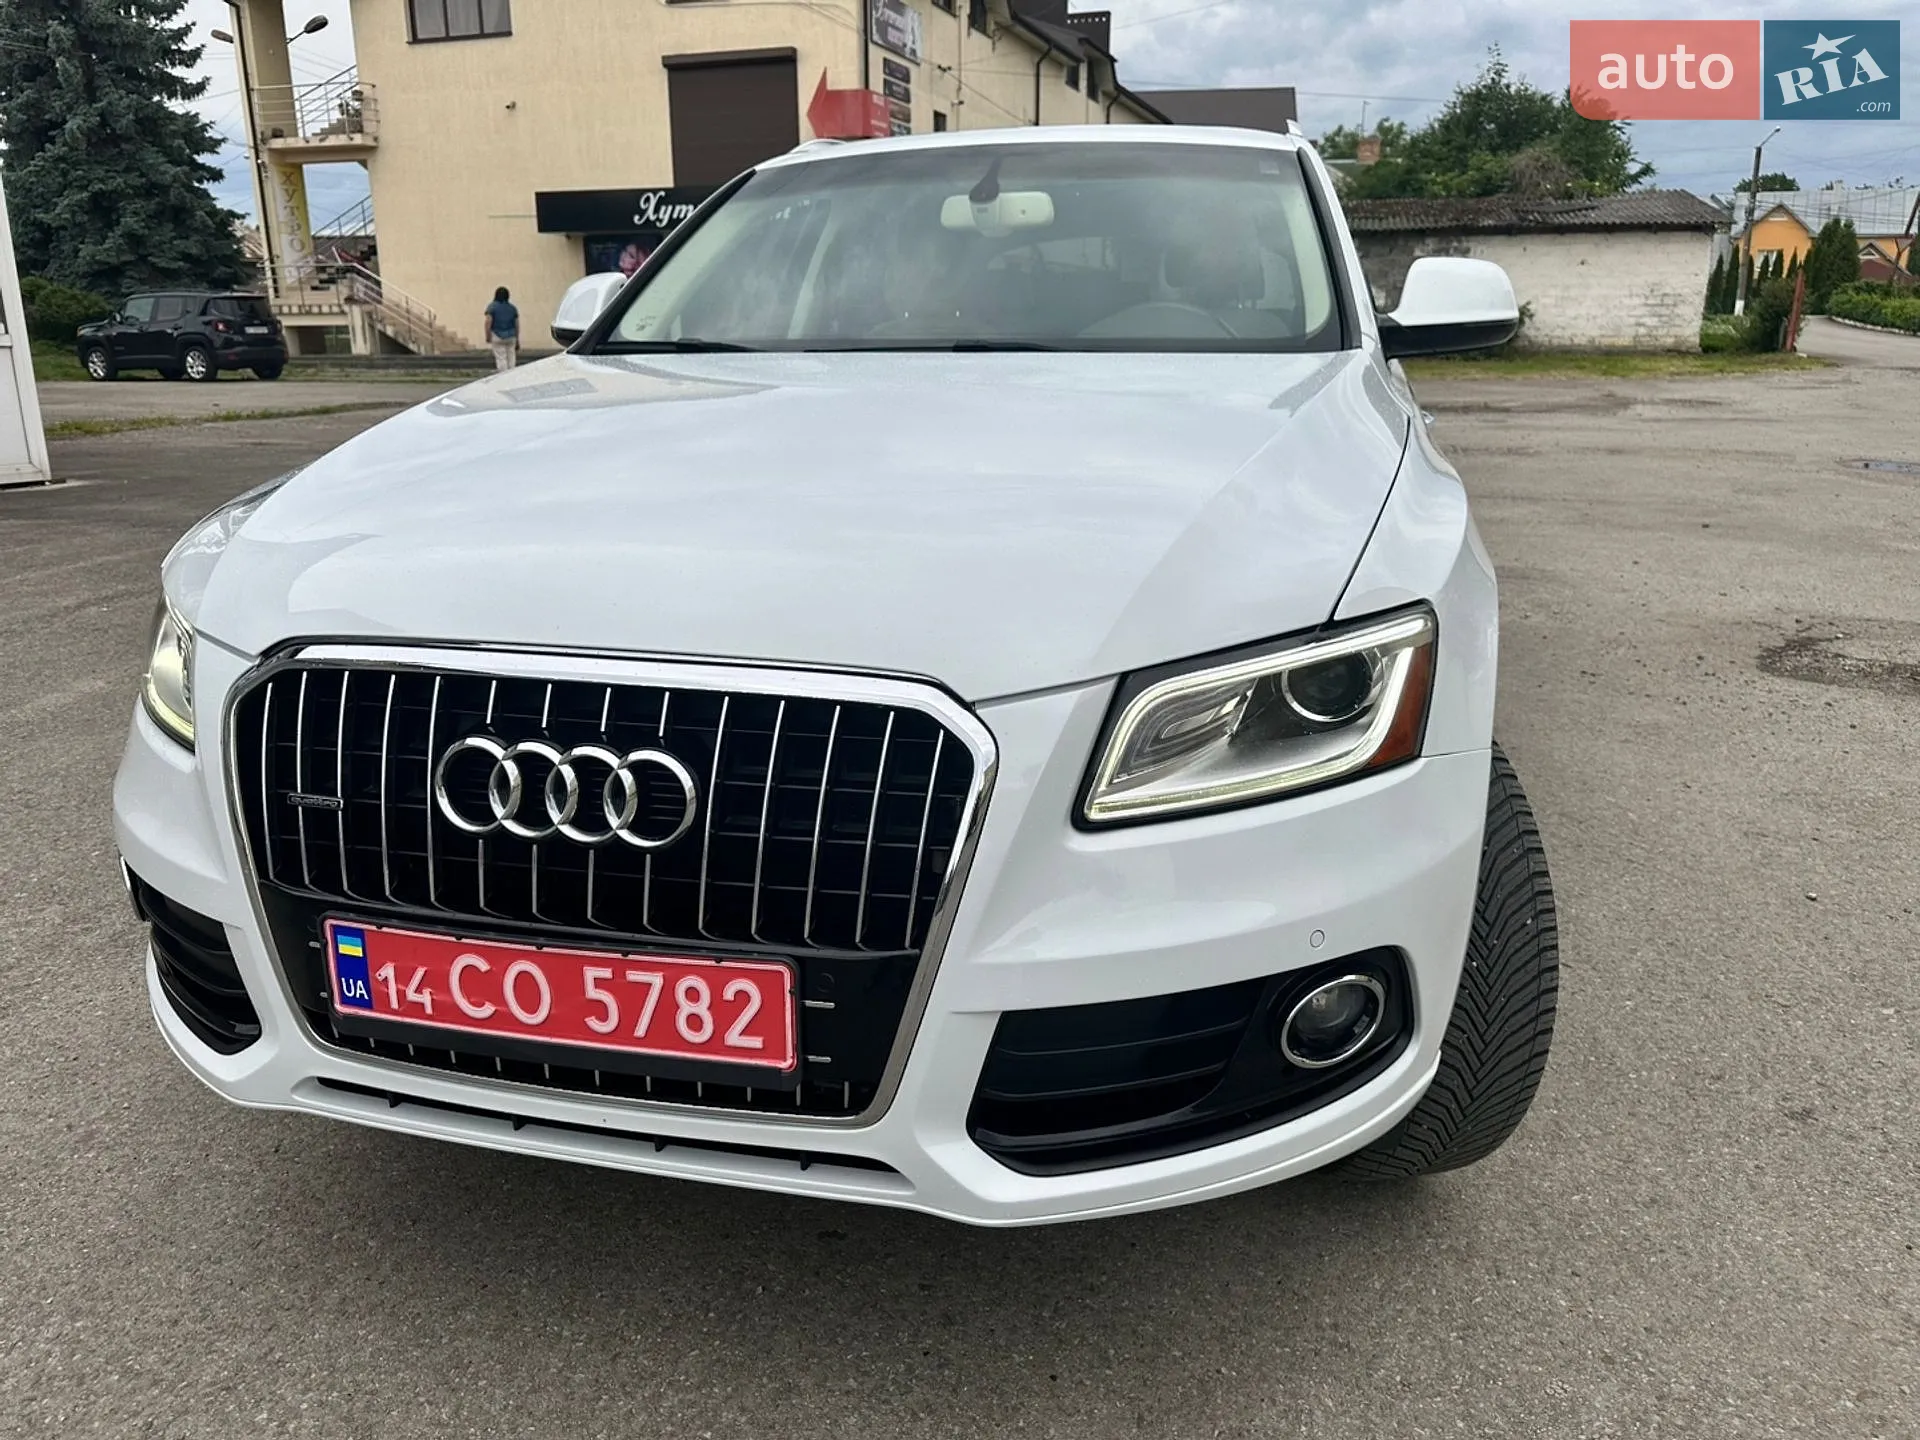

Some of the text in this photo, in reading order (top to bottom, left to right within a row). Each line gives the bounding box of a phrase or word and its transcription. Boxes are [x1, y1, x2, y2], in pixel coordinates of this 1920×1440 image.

[341, 977, 369, 1000] UA
[375, 961, 434, 1015] 14
[583, 966, 764, 1050] 5782
